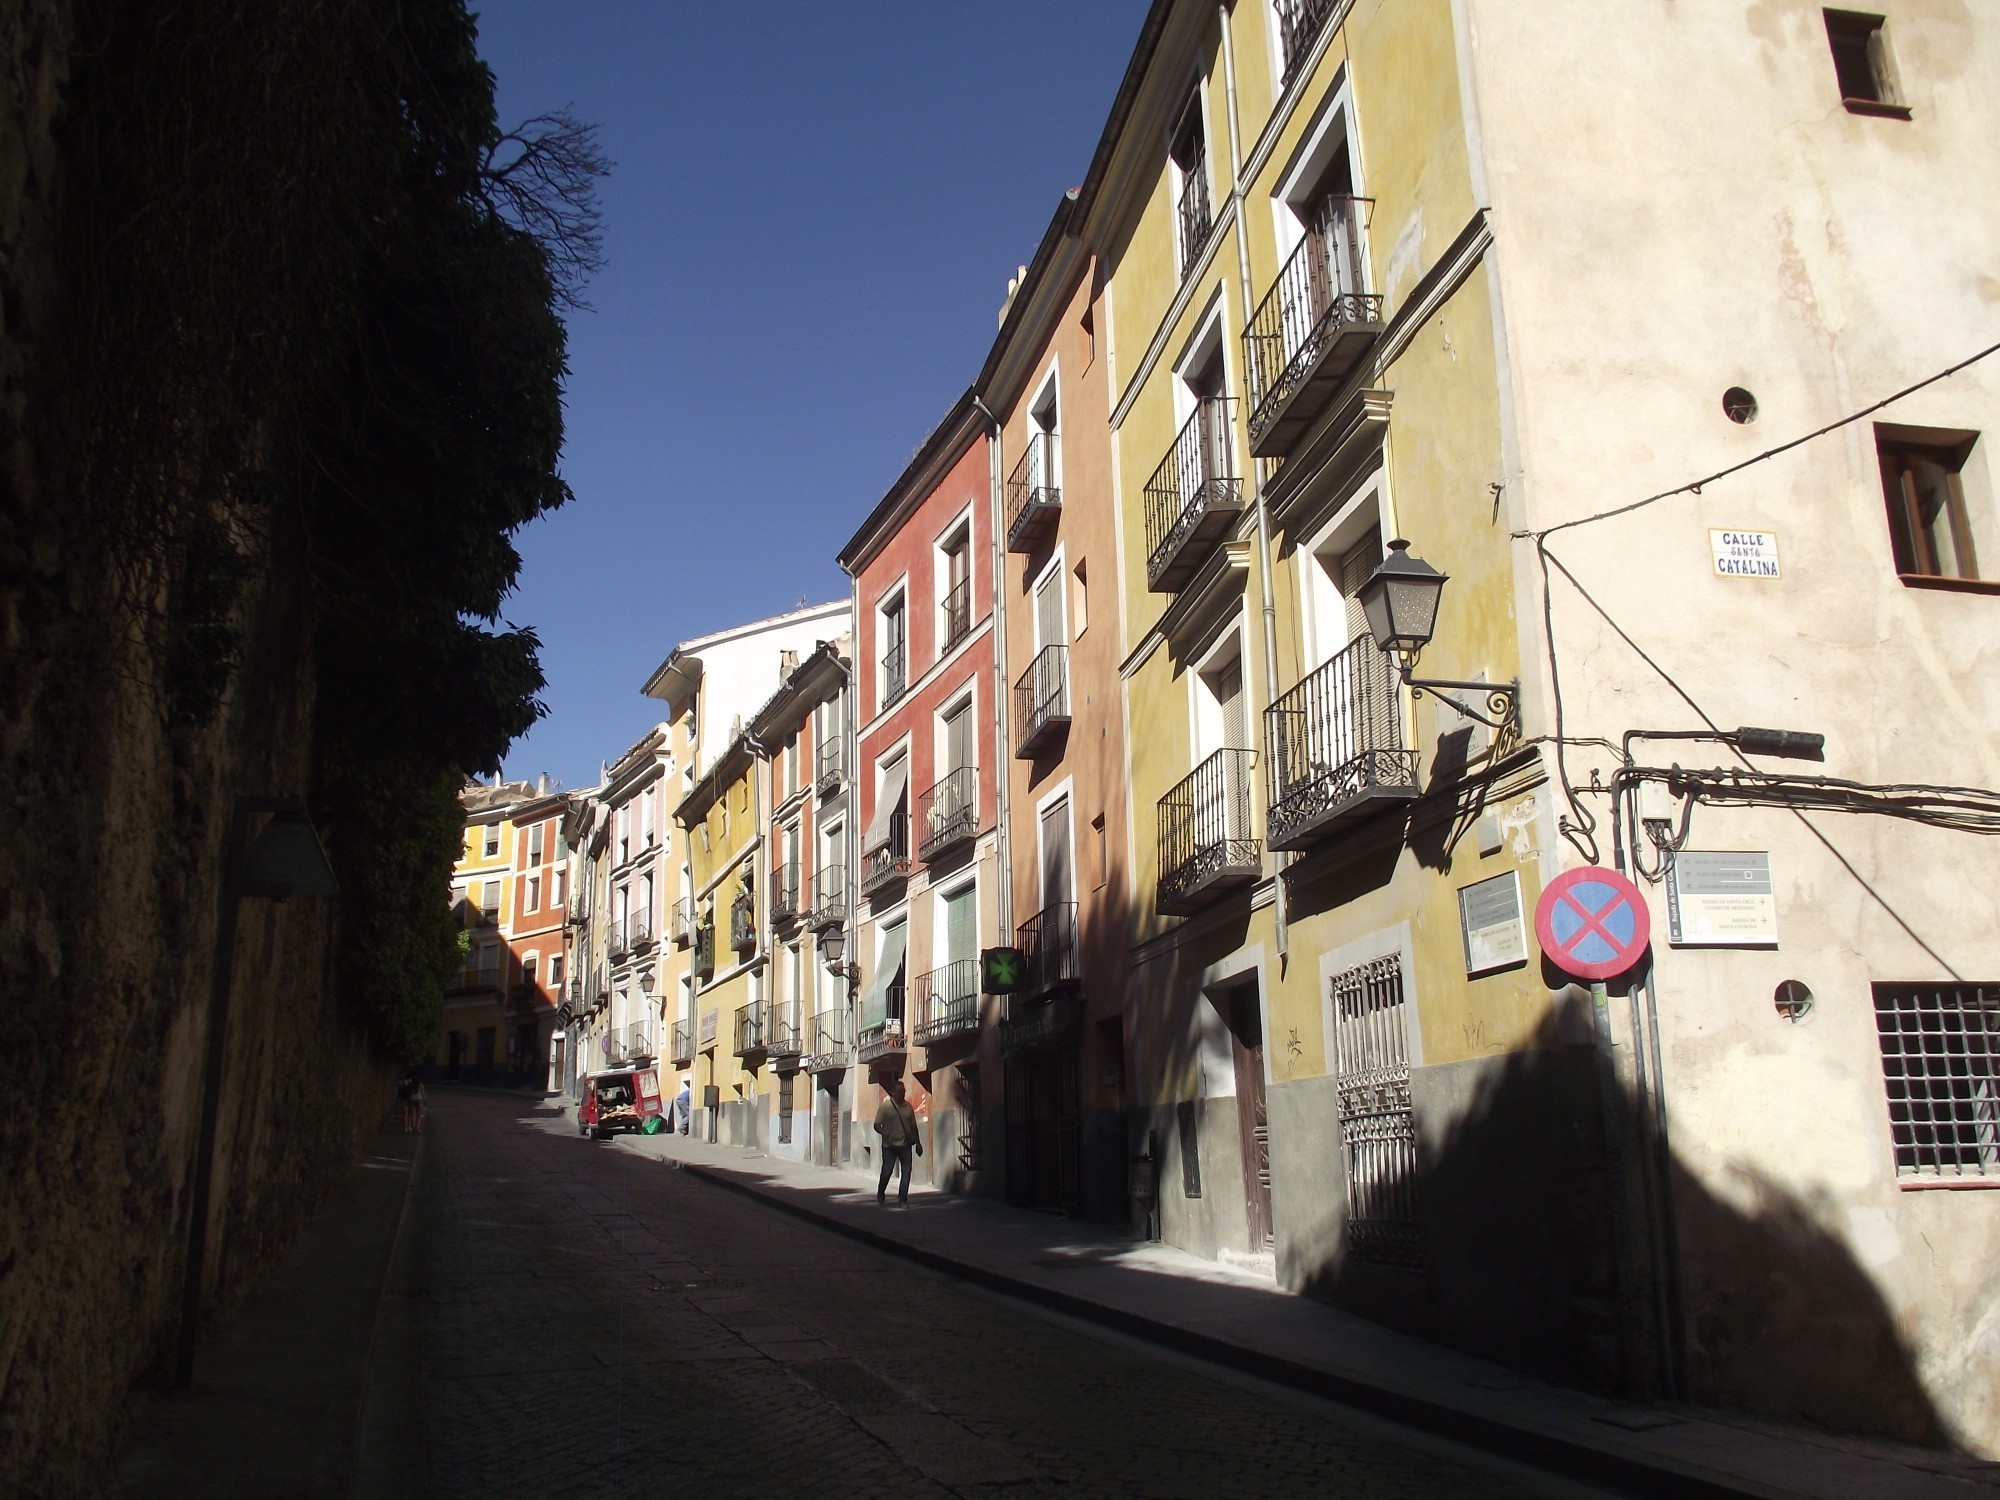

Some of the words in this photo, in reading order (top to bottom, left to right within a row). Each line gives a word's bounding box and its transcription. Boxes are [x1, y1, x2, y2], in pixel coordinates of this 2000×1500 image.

[1723, 533, 1763, 546] CALLE
[1731, 547, 1760, 557] SANTA
[1718, 558, 1778, 576] CATALINA
